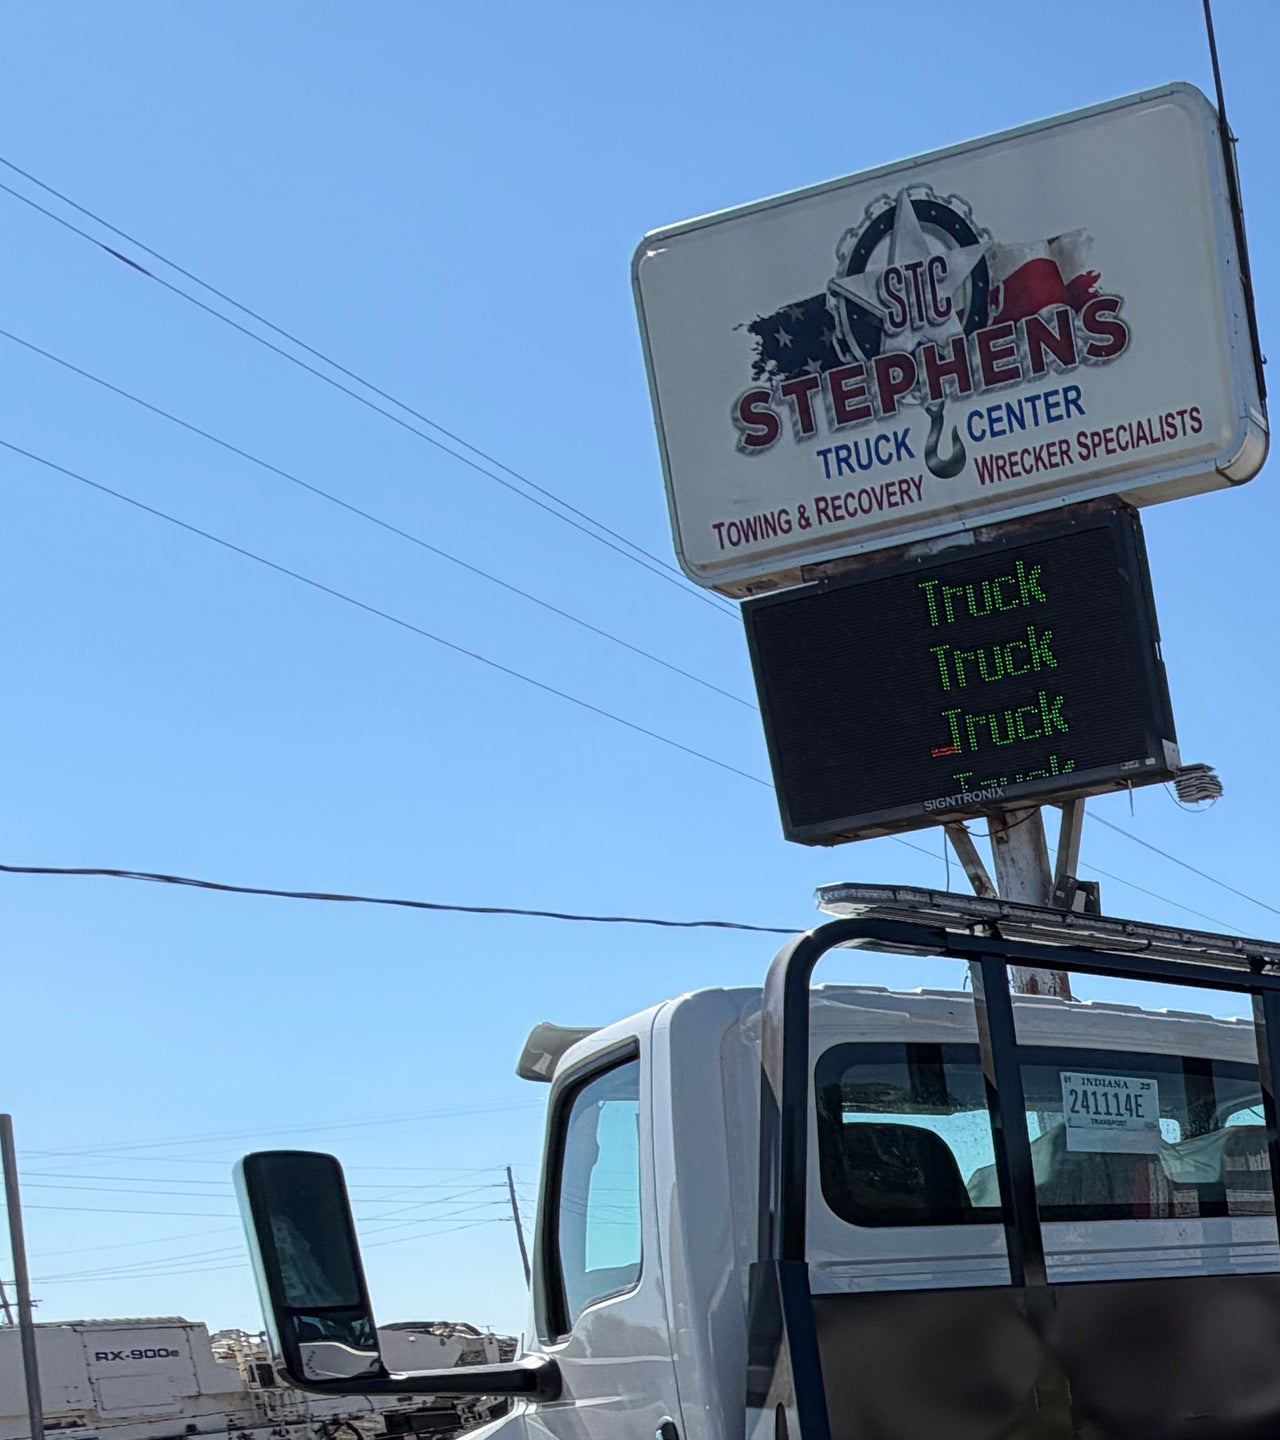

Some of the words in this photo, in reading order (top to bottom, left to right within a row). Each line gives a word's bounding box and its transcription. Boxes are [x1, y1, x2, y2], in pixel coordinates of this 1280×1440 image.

[884, 254, 953, 330] STC
[736, 295, 1130, 451] STEPHENS
[817, 426, 916, 480] TRUCK
[967, 385, 1086, 443] CENTER
[974, 440, 1074, 486] WRECKER
[1077, 406, 1204, 462] SPECIALISTS
[712, 507, 793, 550] TOWING
[797, 503, 812, 529] &
[817, 474, 924, 525] RECOVERY
[918, 560, 1047, 627] Truck
[930, 625, 1058, 691] Truck
[941, 691, 1069, 754] Truck
[924, 787, 1005, 812] SIGNTRONIX
[1069, 1089, 1145, 1118] 241114E
[1081, 1077, 1129, 1090] INDIANA
[94, 1348, 180, 1361] RX-900e
